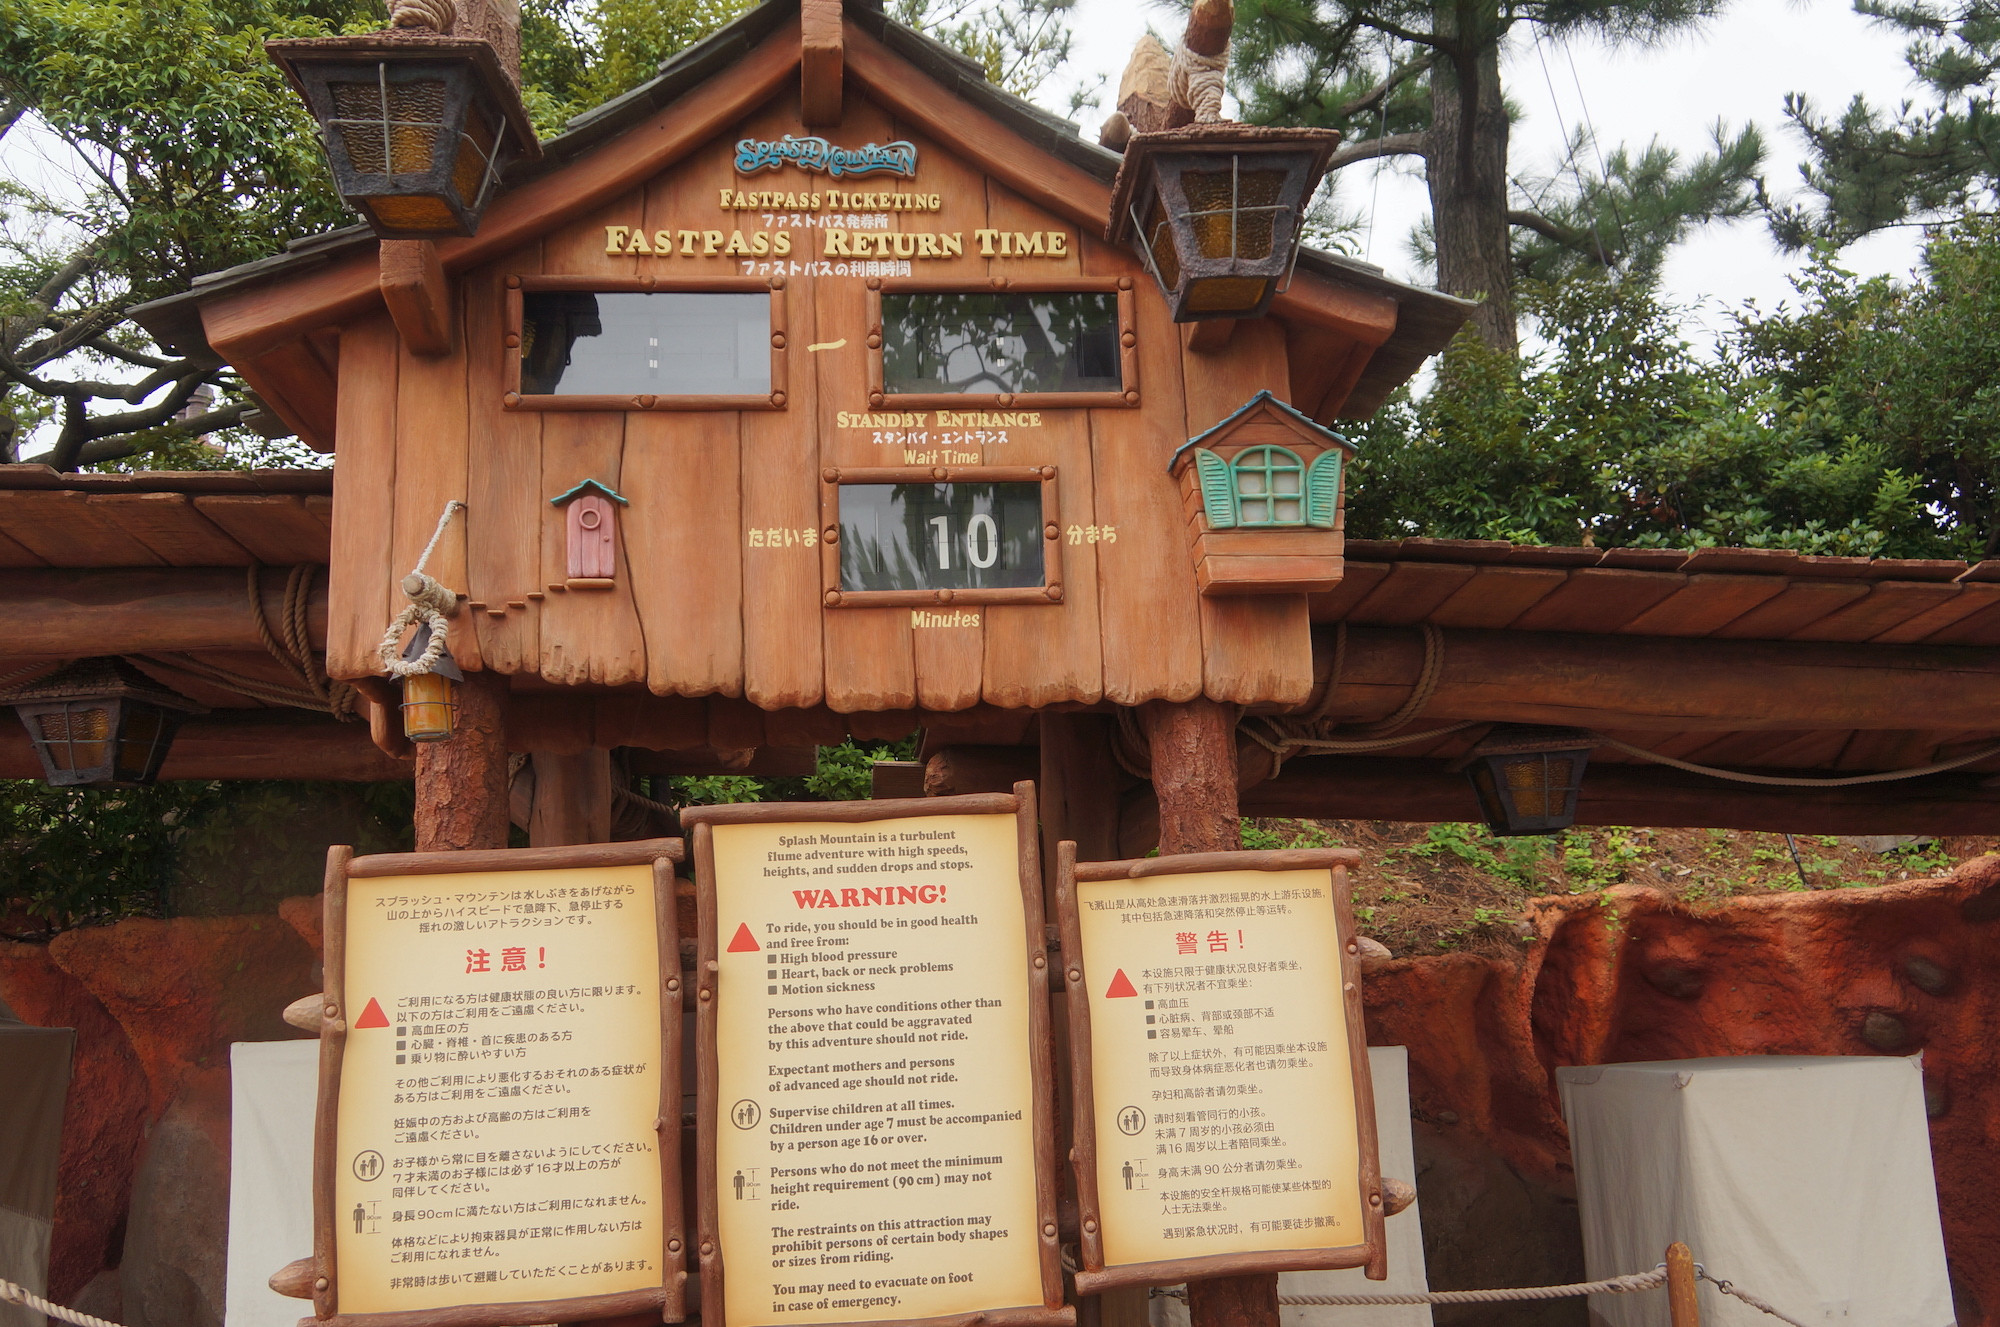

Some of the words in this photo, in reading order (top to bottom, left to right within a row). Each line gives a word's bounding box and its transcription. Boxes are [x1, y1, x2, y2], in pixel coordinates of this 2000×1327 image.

[719, 189, 821, 210] FASTPASS
[826, 190, 941, 212] TICKETING
[761, 214, 888, 229] ファストパス発券所
[605, 226, 791, 257] FASTPASS
[823, 228, 962, 259] RETURN
[975, 229, 1067, 258] TIME
[741, 260, 912, 278] ファストパスの利用時間
[836, 411, 927, 428] STANDBY
[936, 410, 1042, 427] ENTRANCE
[872, 431, 1008, 444] スタンバイ・エントランス
[904, 450, 938, 464] Wait
[941, 450, 979, 464] Time
[748, 527, 818, 548] ただいま
[930, 513, 998, 569] 10
[1066, 525, 1117, 545] 分まち
[912, 610, 980, 628] Minutes
[779, 835, 817, 848] Splash
[820, 833, 876, 844] Mountain
[878, 832, 888, 842] is
[890, 834, 896, 842] a
[899, 830, 956, 841] turbulent
[768, 852, 802, 861] flume
[805, 850, 864, 860] adventure
[867, 847, 895, 858] with
[898, 846, 924, 858] high
[927, 844, 968, 857] speeds,
[763, 866, 809, 878] heights,
[812, 864, 834, 875] and
[836, 863, 878, 874] sudden
[880, 862, 914, 874] drops
[916, 860, 937, 870] and
[940, 860, 973, 871] stops.
[792, 885, 946, 909] WARNING!
[766, 923, 781, 933] To
[784, 922, 811, 934] ride,
[814, 923, 835, 934] you
[838, 918, 877, 930] should
[880, 918, 894, 928] be
[896, 918, 908, 928] in
[911, 916, 938, 929] good
[941, 914, 978, 926] health
[780, 952, 808, 966] High
[811, 951, 844, 962] blood
[847, 951, 897, 963] pressure
[782, 968, 819, 980] Heart,
[822, 966, 850, 977] back
[852, 968, 866, 976] or
[869, 964, 896, 975] neck
[900, 962, 953, 976] problems
[782, 984, 824, 995] Motion
[826, 982, 875, 992] sickness
[1143, 978, 1252, 994] 有下列状况者不宜乘坐：
[768, 1008, 813, 1018] Persons
[816, 1005, 842, 1016] who
[845, 1004, 873, 1014] have
[876, 1001, 938, 1013] conditions
[940, 999, 972, 1010] other
[975, 998, 1002, 1008] than
[1158, 998, 1189, 1010] 高血压
[1159, 1007, 1274, 1024] 心脏病、背部或颈部不适
[412, 1022, 469, 1036] 高血圧の方
[1160, 1024, 1234, 1039] 容易晕车、晕船
[411, 1047, 526, 1064] 乗り物に酔いやすい方
[768, 1064, 830, 1078] Expectant
[832, 1061, 882, 1072] mothers
[884, 1058, 906, 1070] and
[909, 1058, 955, 1071] persons
[1152, 1084, 1263, 1101] 孕妇和高龄者请勿乘坐。
[770, 1105, 829, 1120] Supervise
[832, 1103, 883, 1115] children
[886, 1102, 898, 1112] at
[900, 1100, 916, 1111] all
[918, 1099, 954, 1110] times.
[1154, 1107, 1265, 1125] 请时刻看管同行的小孩。
[770, 1122, 823, 1134] Children
[826, 1120, 862, 1132] under
[864, 1120, 884, 1132] age
[886, 1117, 894, 1129] 7
[897, 1116, 927, 1127] must
[929, 1115, 943, 1125] be
[946, 1110, 1022, 1124] accompanied
[394, 1129, 479, 1143] ご遠慮ください。
[770, 1167, 817, 1178] Persons
[820, 1163, 846, 1174] who
[849, 1162, 864, 1173] do
[867, 1161, 888, 1172] not
[890, 1159, 920, 1170] meet
[922, 1158, 942, 1168] the
[945, 1155, 1002, 1167] minimum
[392, 1182, 490, 1198] 同伴してください。
[770, 1182, 810, 1196] height
[813, 1178, 890, 1193] requirement
[893, 1176, 914, 1189] (90
[916, 1173, 940, 1187] cm)
[944, 1174, 969, 1184] may
[972, 1171, 992, 1182] not
[771, 1199, 799, 1211] ride.
[1162, 1201, 1227, 1215] 人士无法乘坐。
[771, 1226, 794, 1238] The
[797, 1223, 857, 1236] restraints
[860, 1224, 875, 1232] on
[878, 1220, 901, 1231] this
[904, 1216, 964, 1229] attraction
[967, 1216, 992, 1226] may
[772, 1240, 822, 1256] prohibit
[826, 1238, 872, 1252] persons
[876, 1234, 888, 1246] of
[891, 1232, 934, 1245] certain
[937, 1230, 966, 1243] body
[969, 1229, 1008, 1241] shapes
[391, 1246, 499, 1263] ご利用になれません。
[772, 1284, 796, 1295] You
[799, 1284, 824, 1295] may
[828, 1279, 856, 1292] need
[859, 1280, 872, 1290] to
[874, 1276, 928, 1288] evacuate
[931, 1276, 946, 1284] on
[948, 1272, 973, 1283] foot
